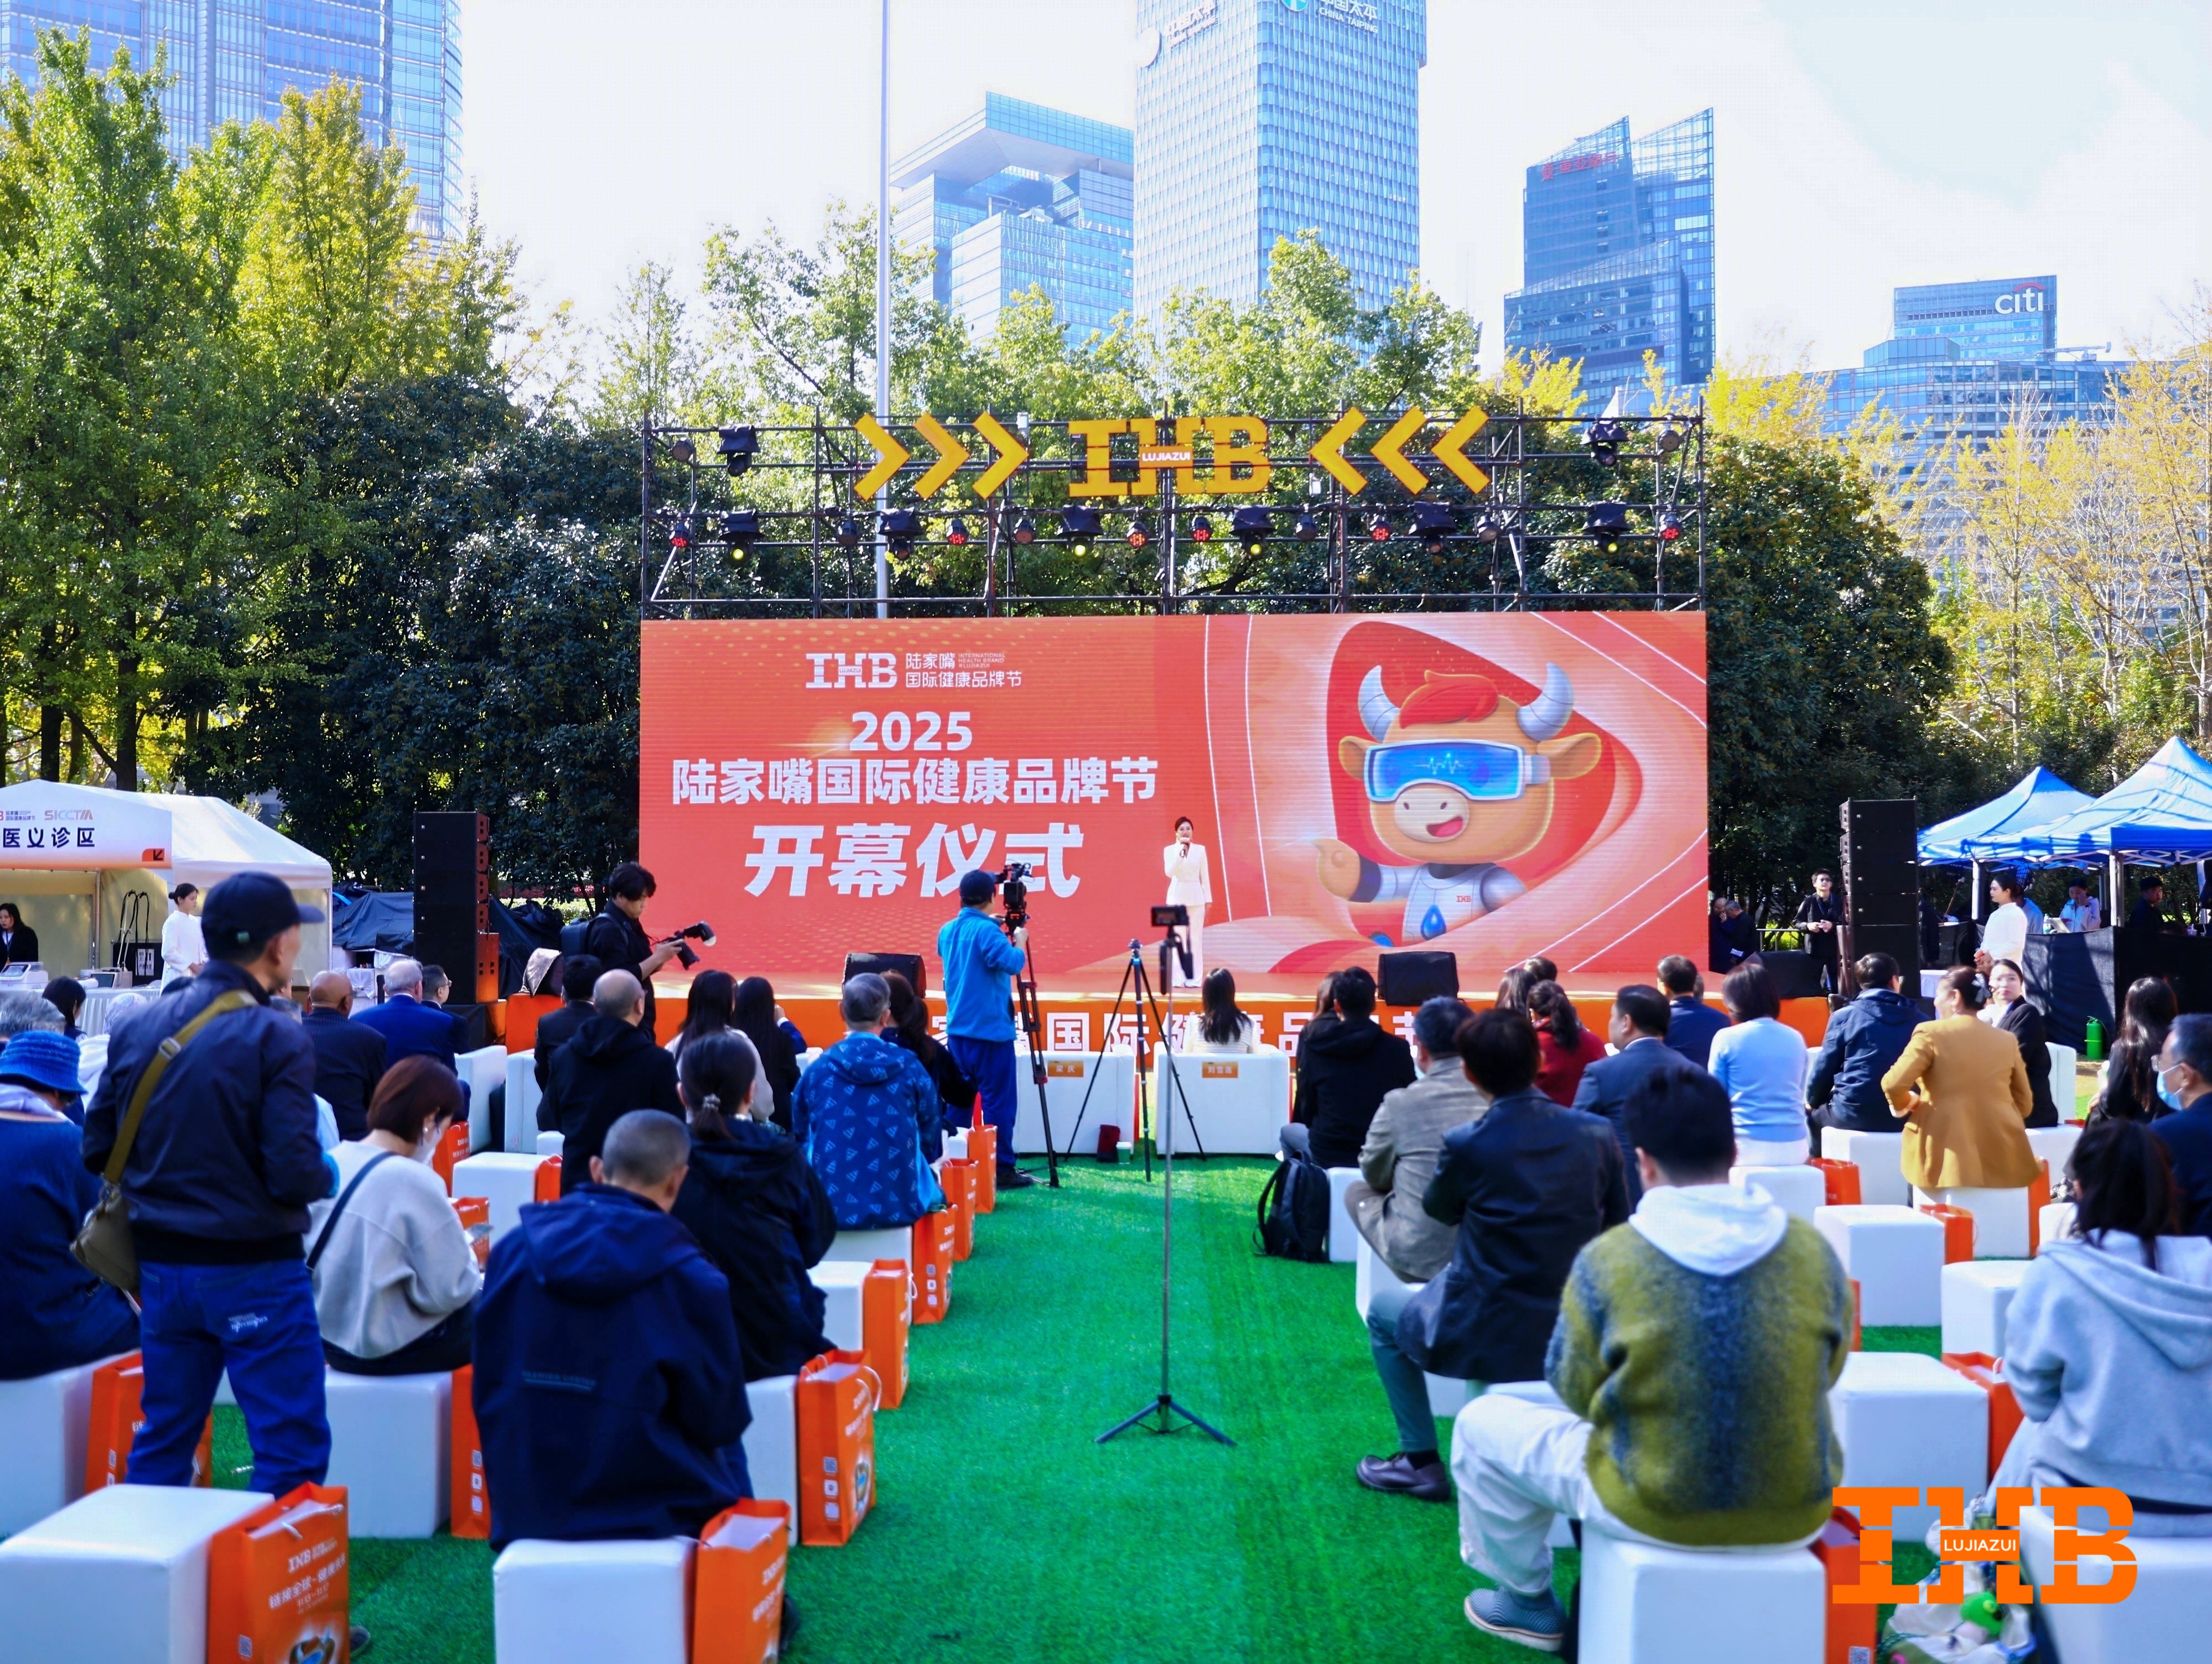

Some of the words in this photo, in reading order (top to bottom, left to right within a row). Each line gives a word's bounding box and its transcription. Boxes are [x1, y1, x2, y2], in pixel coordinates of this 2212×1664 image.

[1319, 7, 1344, 22] CHINA
[1346, 16, 1378, 33] TAIPING
[1995, 287, 2044, 314] citi
[1141, 451, 1191, 462] LUJIAZUI
[806, 653, 897, 688] IHB
[906, 653, 956, 669] 陆家嘴
[906, 670, 1022, 688] 国际健康品牌节
[849, 711, 973, 751] 2025
[672, 756, 1158, 805] 陆家嘴国际健康品牌节
[3, 827, 95, 849] 医义诊区
[744, 822, 1084, 898] 开幕仪式
